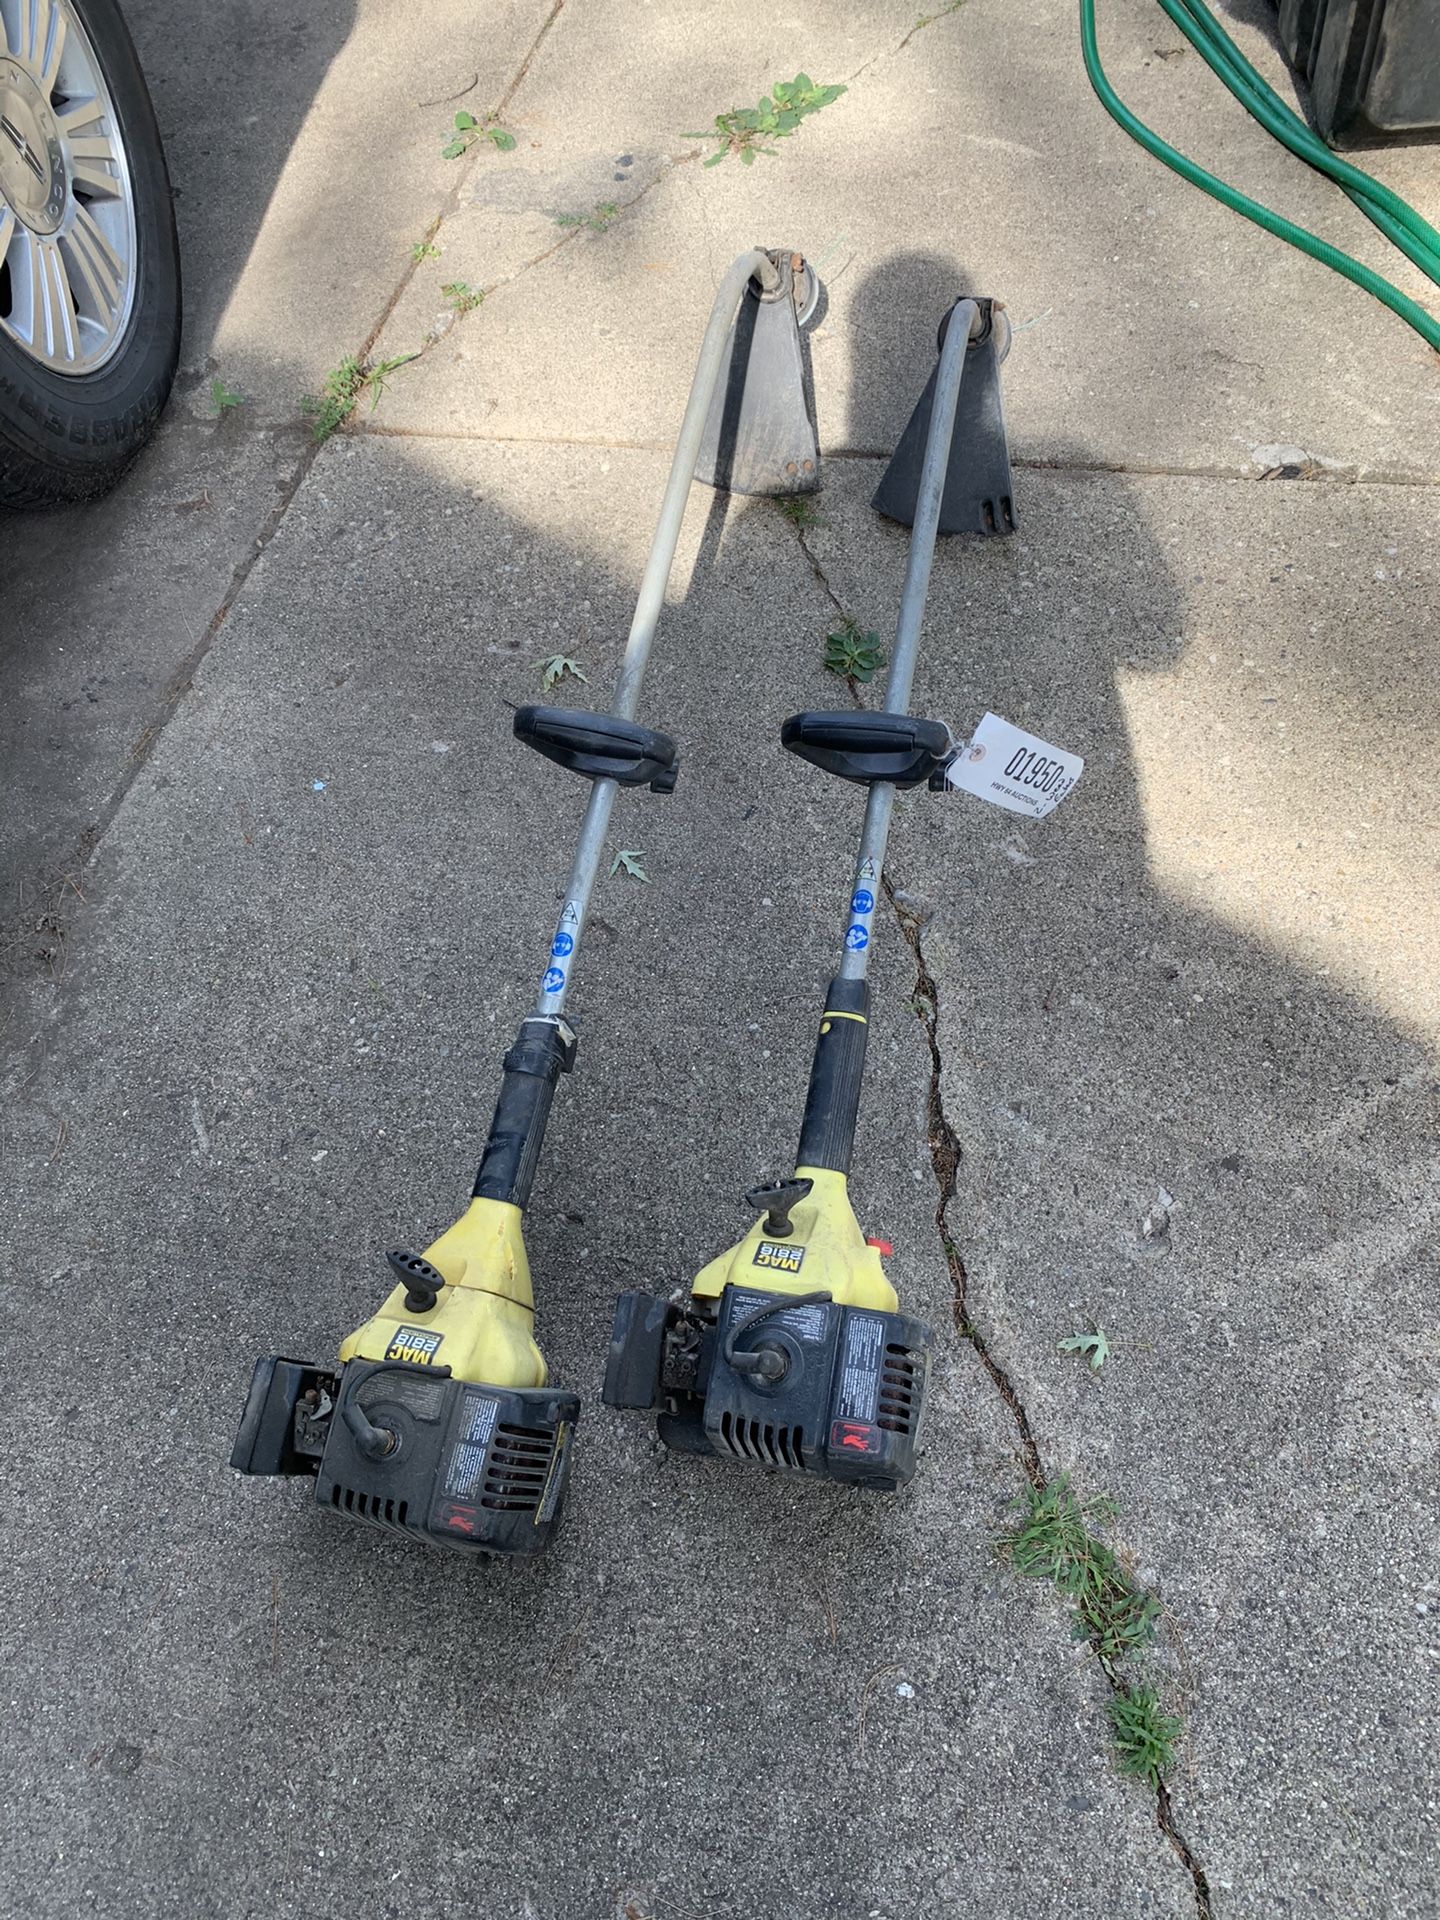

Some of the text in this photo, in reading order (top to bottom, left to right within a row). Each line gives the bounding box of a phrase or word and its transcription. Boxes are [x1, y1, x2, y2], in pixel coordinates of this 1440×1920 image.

[1004, 747, 1064, 792] 01950
[990, 781, 1005, 791] HWY
[1011, 791, 1039, 806] AUCTIONS
[760, 1246, 802, 1260] 2816
[757, 1255, 800, 1271] MAC
[395, 1334, 438, 1351] 2818
[389, 1344, 431, 1365] MAC
